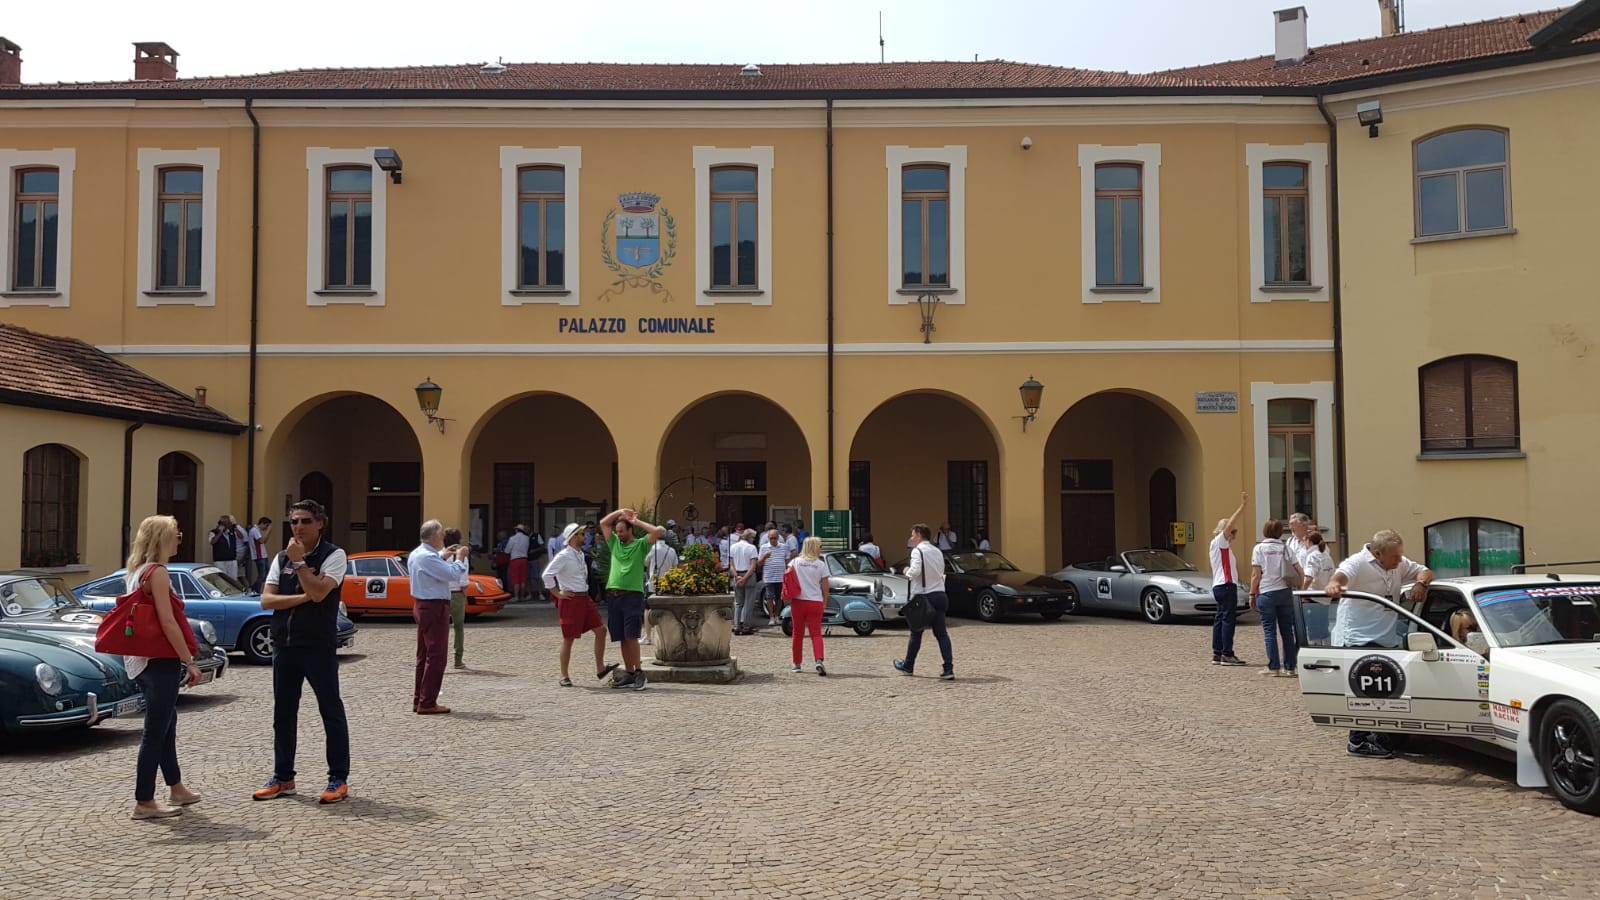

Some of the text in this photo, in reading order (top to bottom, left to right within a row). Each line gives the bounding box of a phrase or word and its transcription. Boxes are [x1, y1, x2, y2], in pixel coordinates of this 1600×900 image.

[559, 318, 715, 333] PALAZZO COMUNALE
[1360, 675, 1392, 691] P11
[1493, 704, 1520, 716] MARTINI
[1493, 711, 1520, 723] RACING
[1333, 716, 1495, 734] PORSCHE
